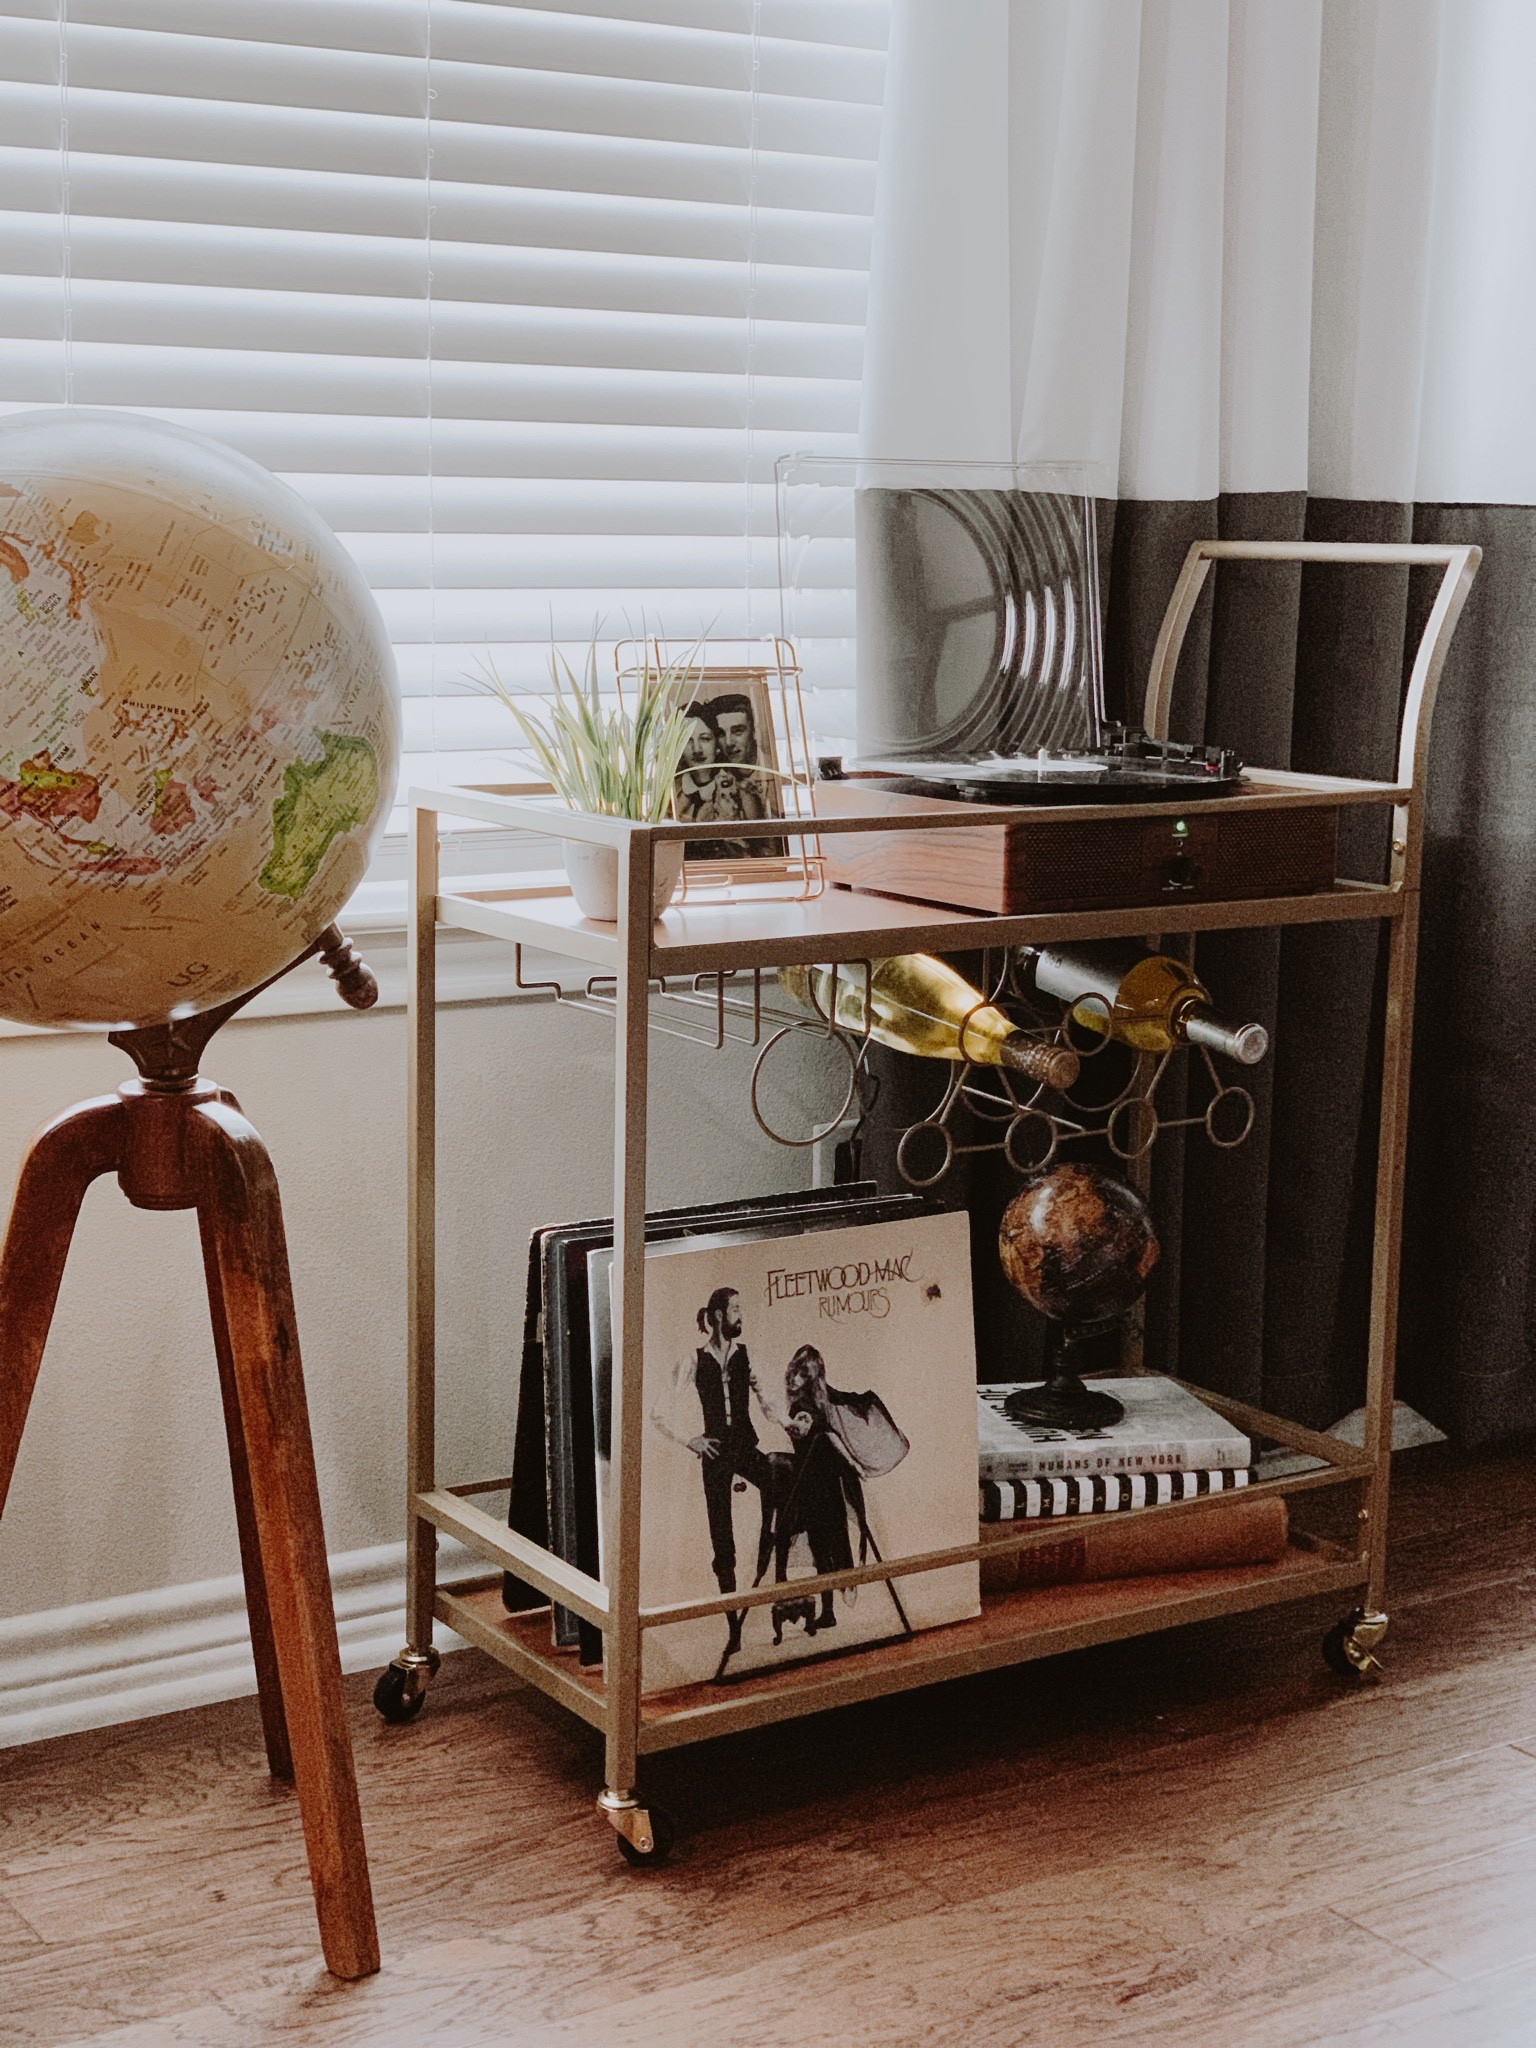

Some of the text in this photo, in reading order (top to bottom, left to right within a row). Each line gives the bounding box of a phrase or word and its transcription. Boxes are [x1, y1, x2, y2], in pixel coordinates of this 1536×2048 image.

[38, 592, 58, 612] SOUTH
[43, 596, 63, 616] KOREA
[122, 699, 187, 716] PHILIPPINES
[263, 758, 279, 776] TIMOR
[43, 921, 101, 963] OCEAN
[764, 1247, 925, 1307] FLEETWOOD MAC
[819, 1286, 891, 1324] RUMOURS
[1039, 1458, 1090, 1471] HUMANS
[1097, 1457, 1111, 1468] OF
[1118, 1455, 1144, 1467] NEW
[1150, 1453, 1182, 1466] YORK
